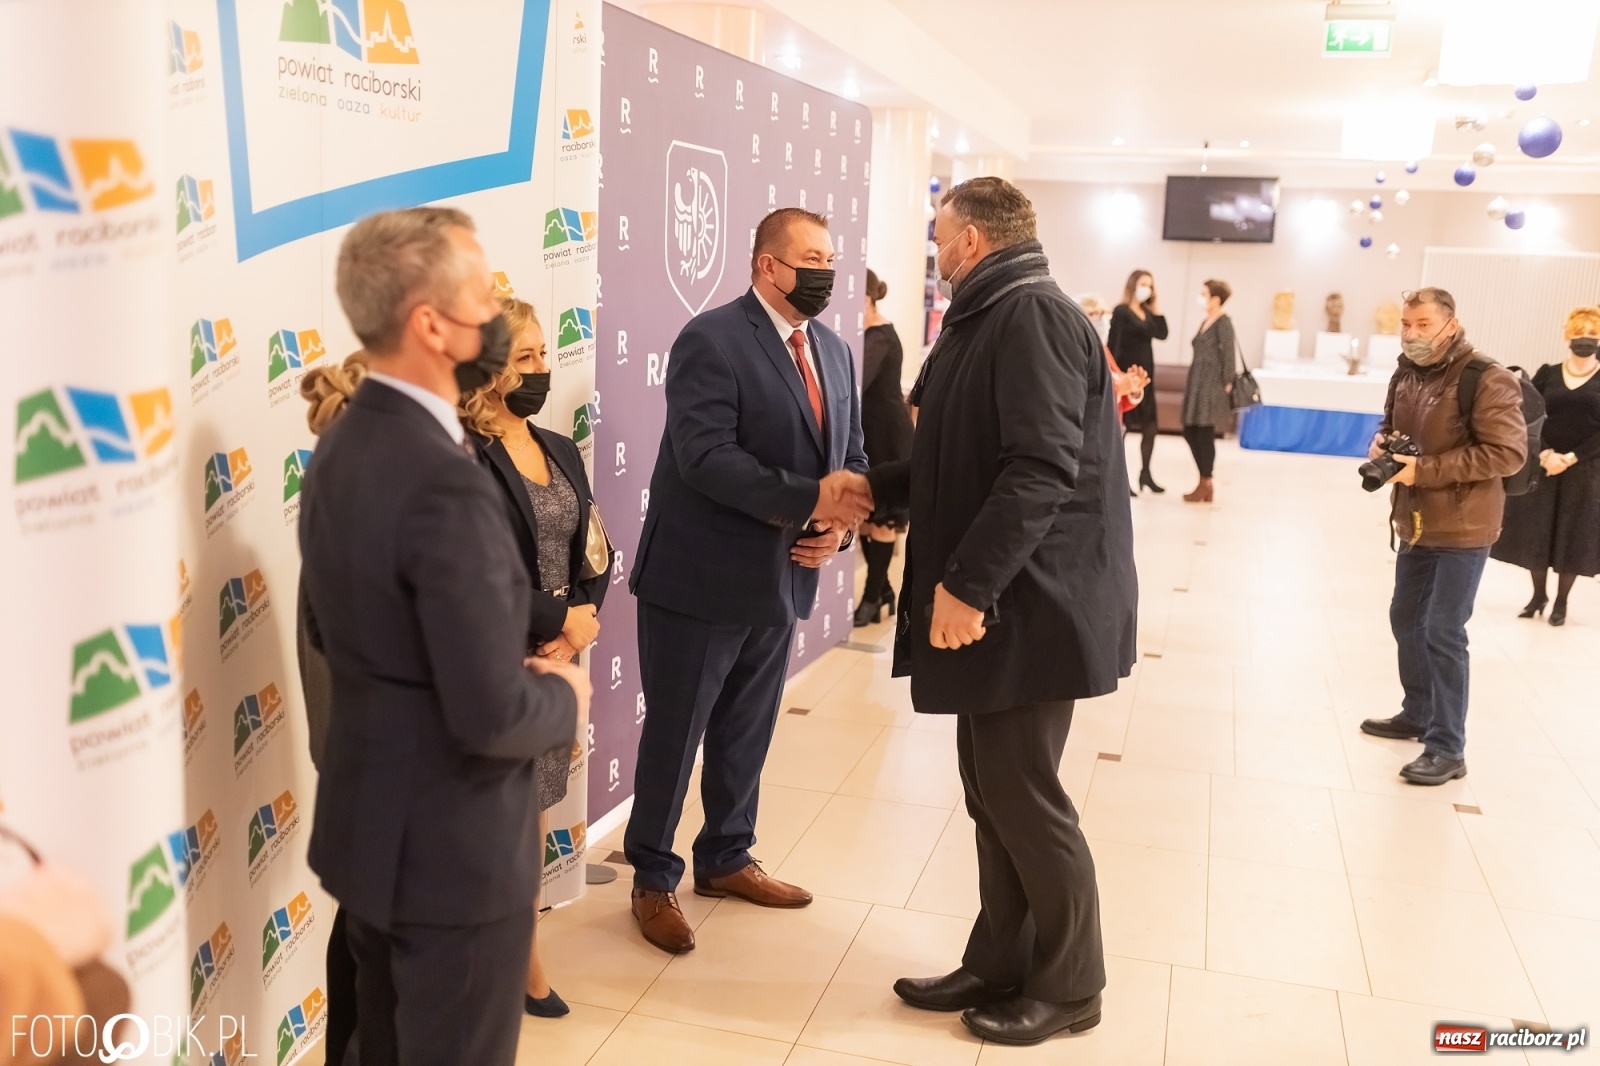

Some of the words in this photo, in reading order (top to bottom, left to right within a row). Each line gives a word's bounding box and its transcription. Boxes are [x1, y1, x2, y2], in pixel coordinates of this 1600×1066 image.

[278, 56, 334, 85] powiat
[344, 69, 421, 102] raciborski
[278, 85, 328, 107] zielona
[337, 98, 370, 115] oaza
[380, 102, 421, 122] kultur
[543, 247, 572, 263] powiat
[558, 345, 585, 363] powiat
[617, 330, 628, 354] R
[268, 378, 292, 400] powiat
[616, 441, 625, 466] R
[614, 550, 624, 574] R
[611, 656, 621, 680] R
[636, 691, 646, 715] R
[609, 758, 619, 782] R
[262, 951, 284, 986] powiat
[285, 911, 316, 953] raciborski
